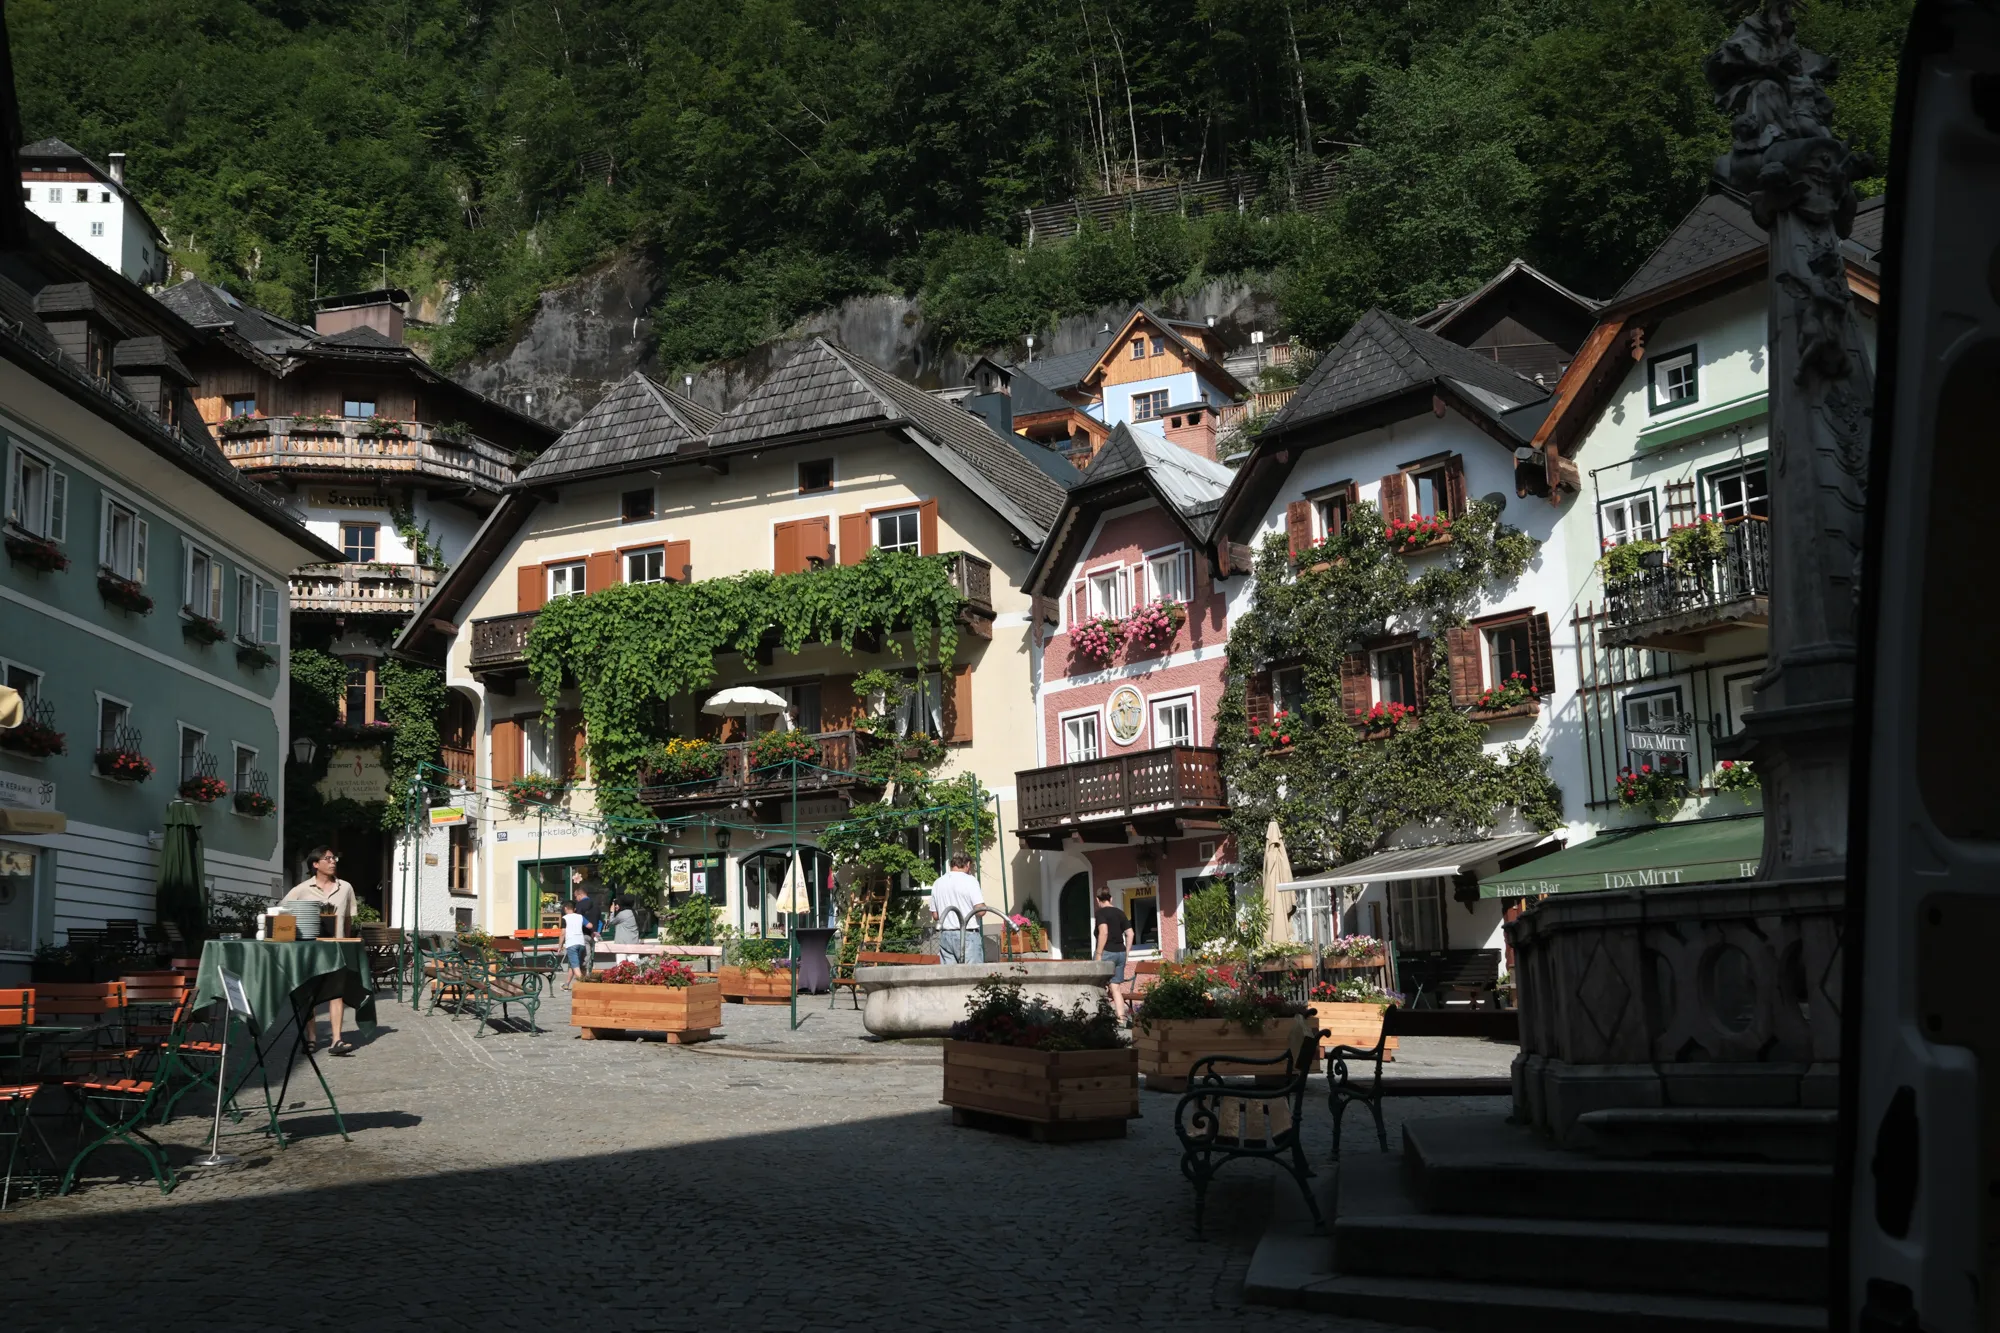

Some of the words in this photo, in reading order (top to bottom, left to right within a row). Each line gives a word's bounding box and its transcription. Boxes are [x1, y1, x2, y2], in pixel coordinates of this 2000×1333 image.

[1655, 734, 1686, 750] MITT
[1638, 869, 1683, 886] MITT
[1135, 887, 1152, 897] ATM
[1497, 882, 1526, 897] Hotel
[1540, 881, 1560, 894] Bar
